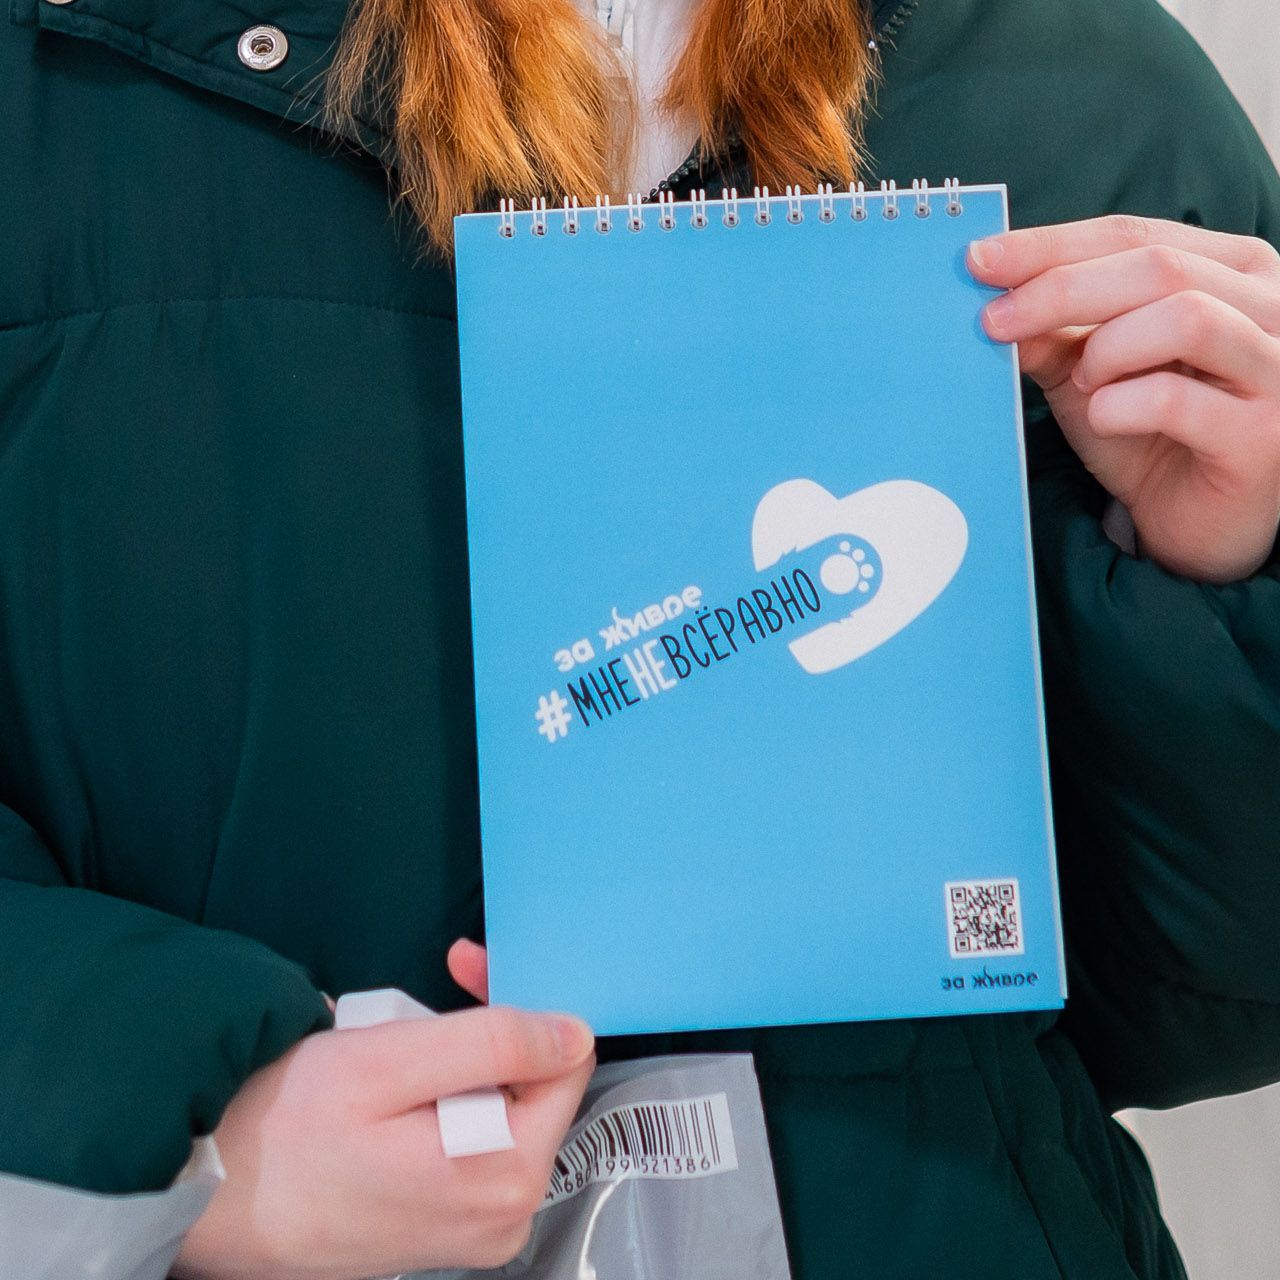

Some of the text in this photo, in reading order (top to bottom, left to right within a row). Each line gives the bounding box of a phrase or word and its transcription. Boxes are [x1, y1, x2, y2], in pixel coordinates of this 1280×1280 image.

[534, 568, 822, 744] #МНЕНЕВСЁРАВНО
[553, 585, 704, 673] за живое
[941, 964, 1039, 990] за живое
[641, 1156, 711, 1175] 521386
